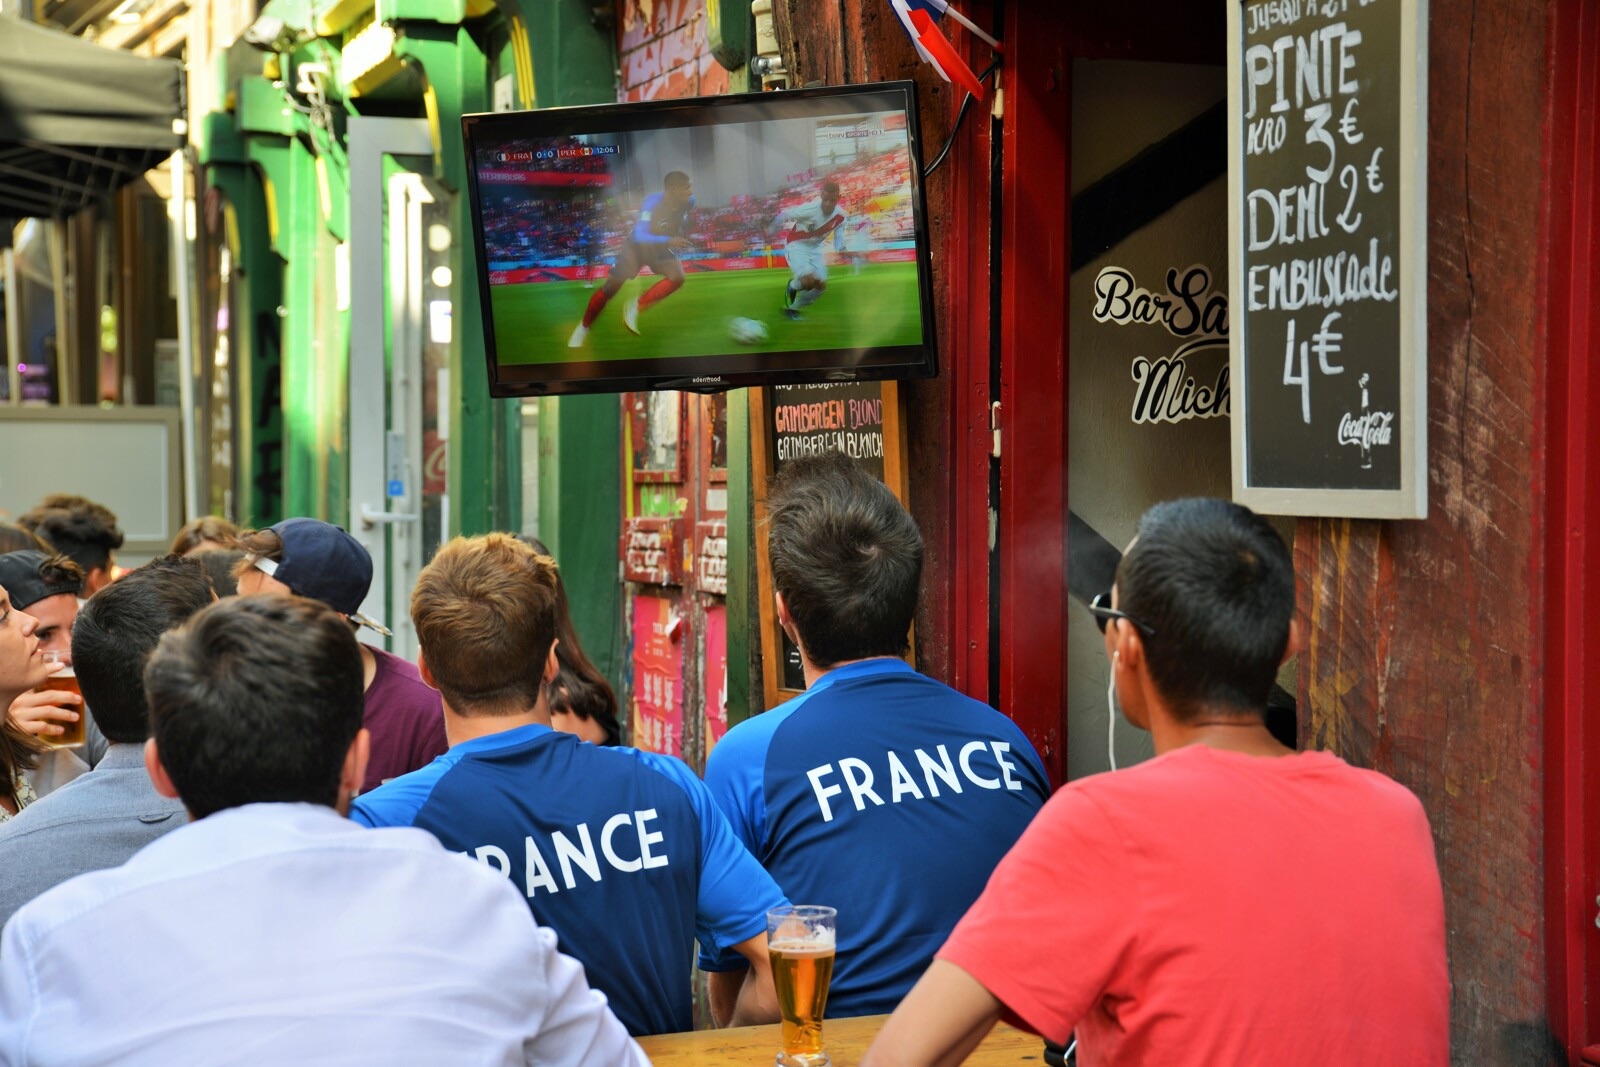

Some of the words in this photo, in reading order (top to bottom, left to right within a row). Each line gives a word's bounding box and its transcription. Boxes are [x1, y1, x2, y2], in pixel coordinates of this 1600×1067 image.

[1245, 22, 1362, 118] PINTE
[596, 146, 614, 154] 12:06
[1247, 115, 1287, 155] KRO
[1247, 182, 1329, 252] DEMI
[692, 375, 721, 383] edenwood
[775, 400, 845, 433] GRIMBERGEN
[806, 741, 1023, 822] FRANCE
[458, 808, 669, 898] RANCE
